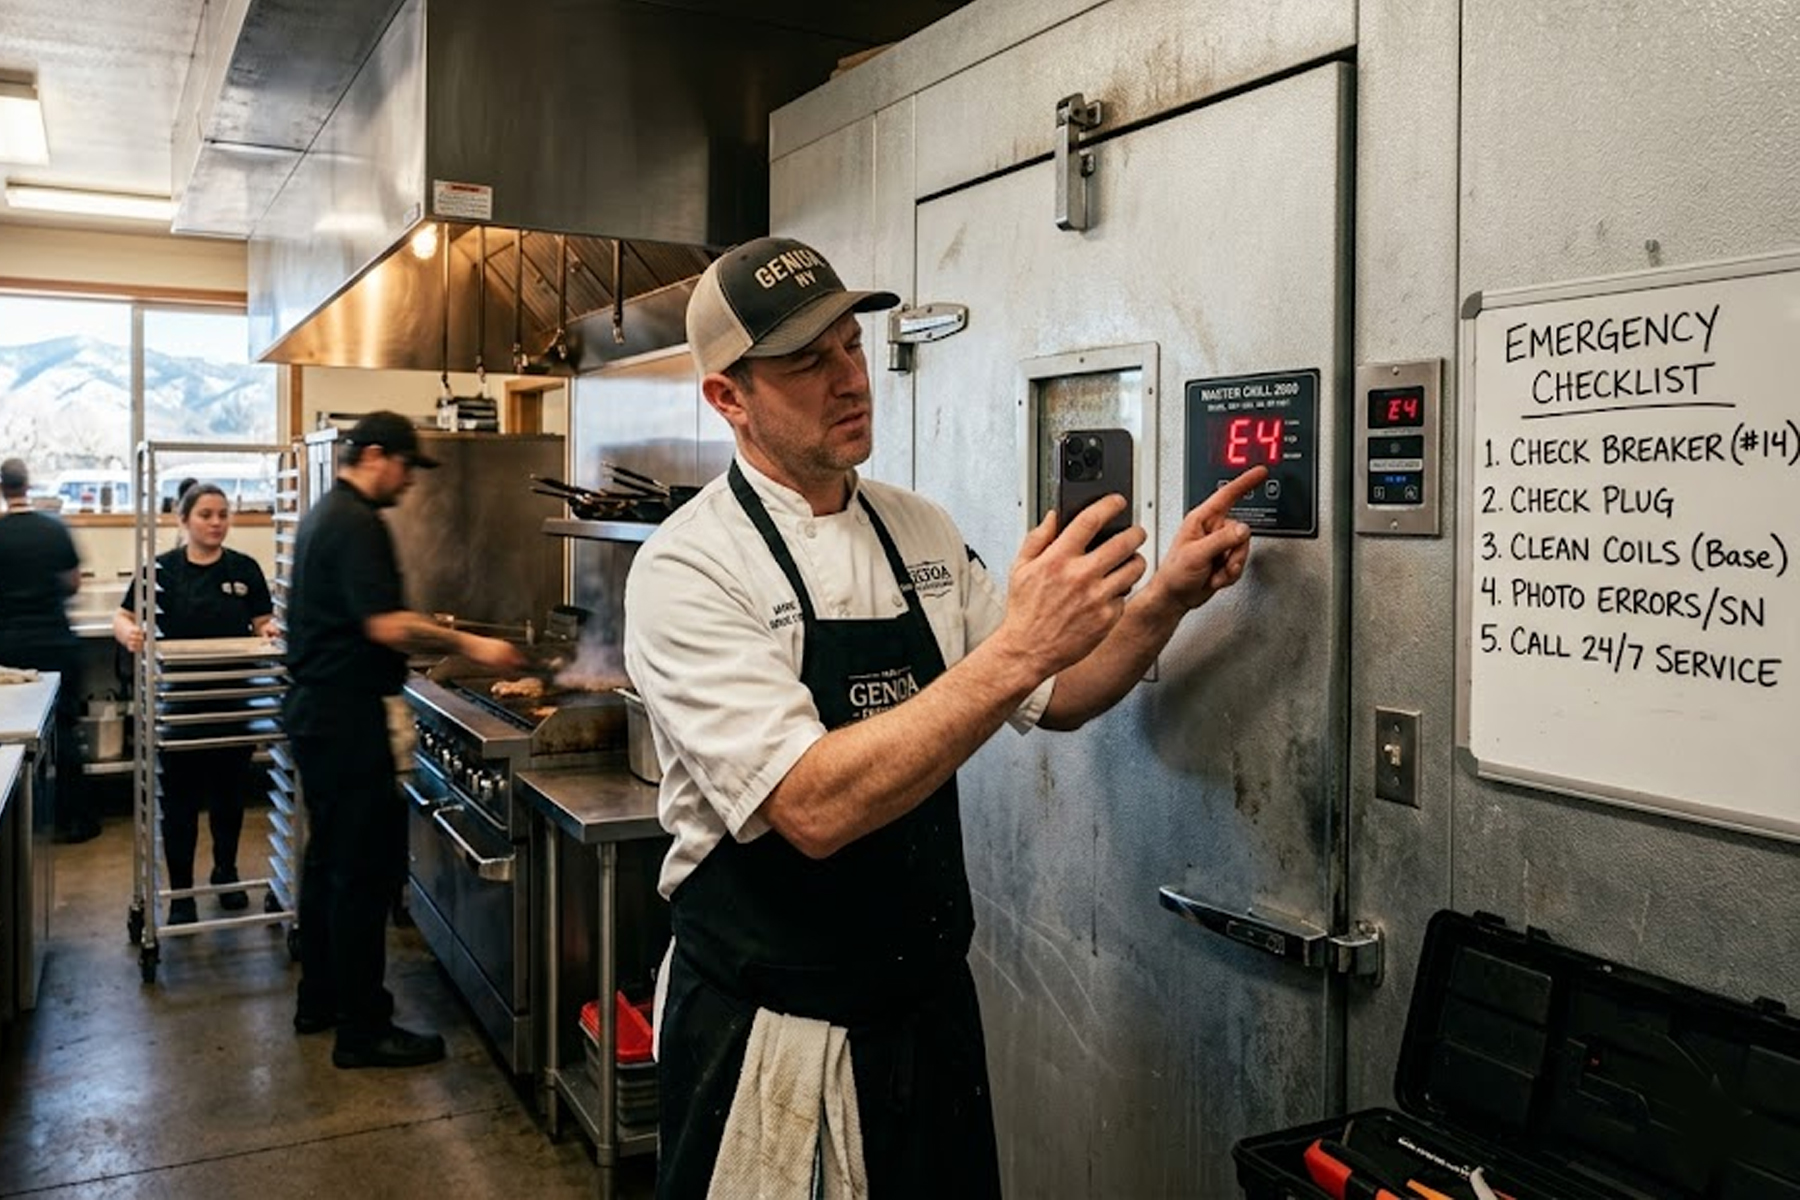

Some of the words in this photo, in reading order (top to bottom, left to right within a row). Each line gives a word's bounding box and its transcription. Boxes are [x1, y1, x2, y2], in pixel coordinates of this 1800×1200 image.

[1506, 304, 1720, 363] EMERGENCY
[1532, 362, 1716, 404] CHECKLIST
[1388, 399, 1417, 420] E4
[1228, 418, 1281, 463] E4
[1485, 438, 1500, 468] 1.
[1510, 437, 1590, 466] CHECK
[1602, 434, 1725, 465] BREAKER
[1730, 419, 1800, 467] (#14)
[1481, 485, 1503, 514] 2.
[1510, 486, 1591, 514] CHECK
[1602, 485, 1675, 519] PLUG
[1481, 532, 1502, 561] 3.
[1510, 532, 1590, 561] CLEAN
[1603, 535, 1681, 566] COILS
[1691, 532, 1789, 578] (Base)
[1481, 576, 1502, 606] 4.
[1511, 578, 1585, 610] PHOTO
[1597, 587, 1765, 631] ERRORS/SN
[1481, 624, 1502, 652] 5.
[1510, 625, 1571, 658] CALL
[1582, 632, 1644, 673] 24/7
[1655, 644, 1782, 687] SERVICE
[849, 671, 919, 707] GENOA
